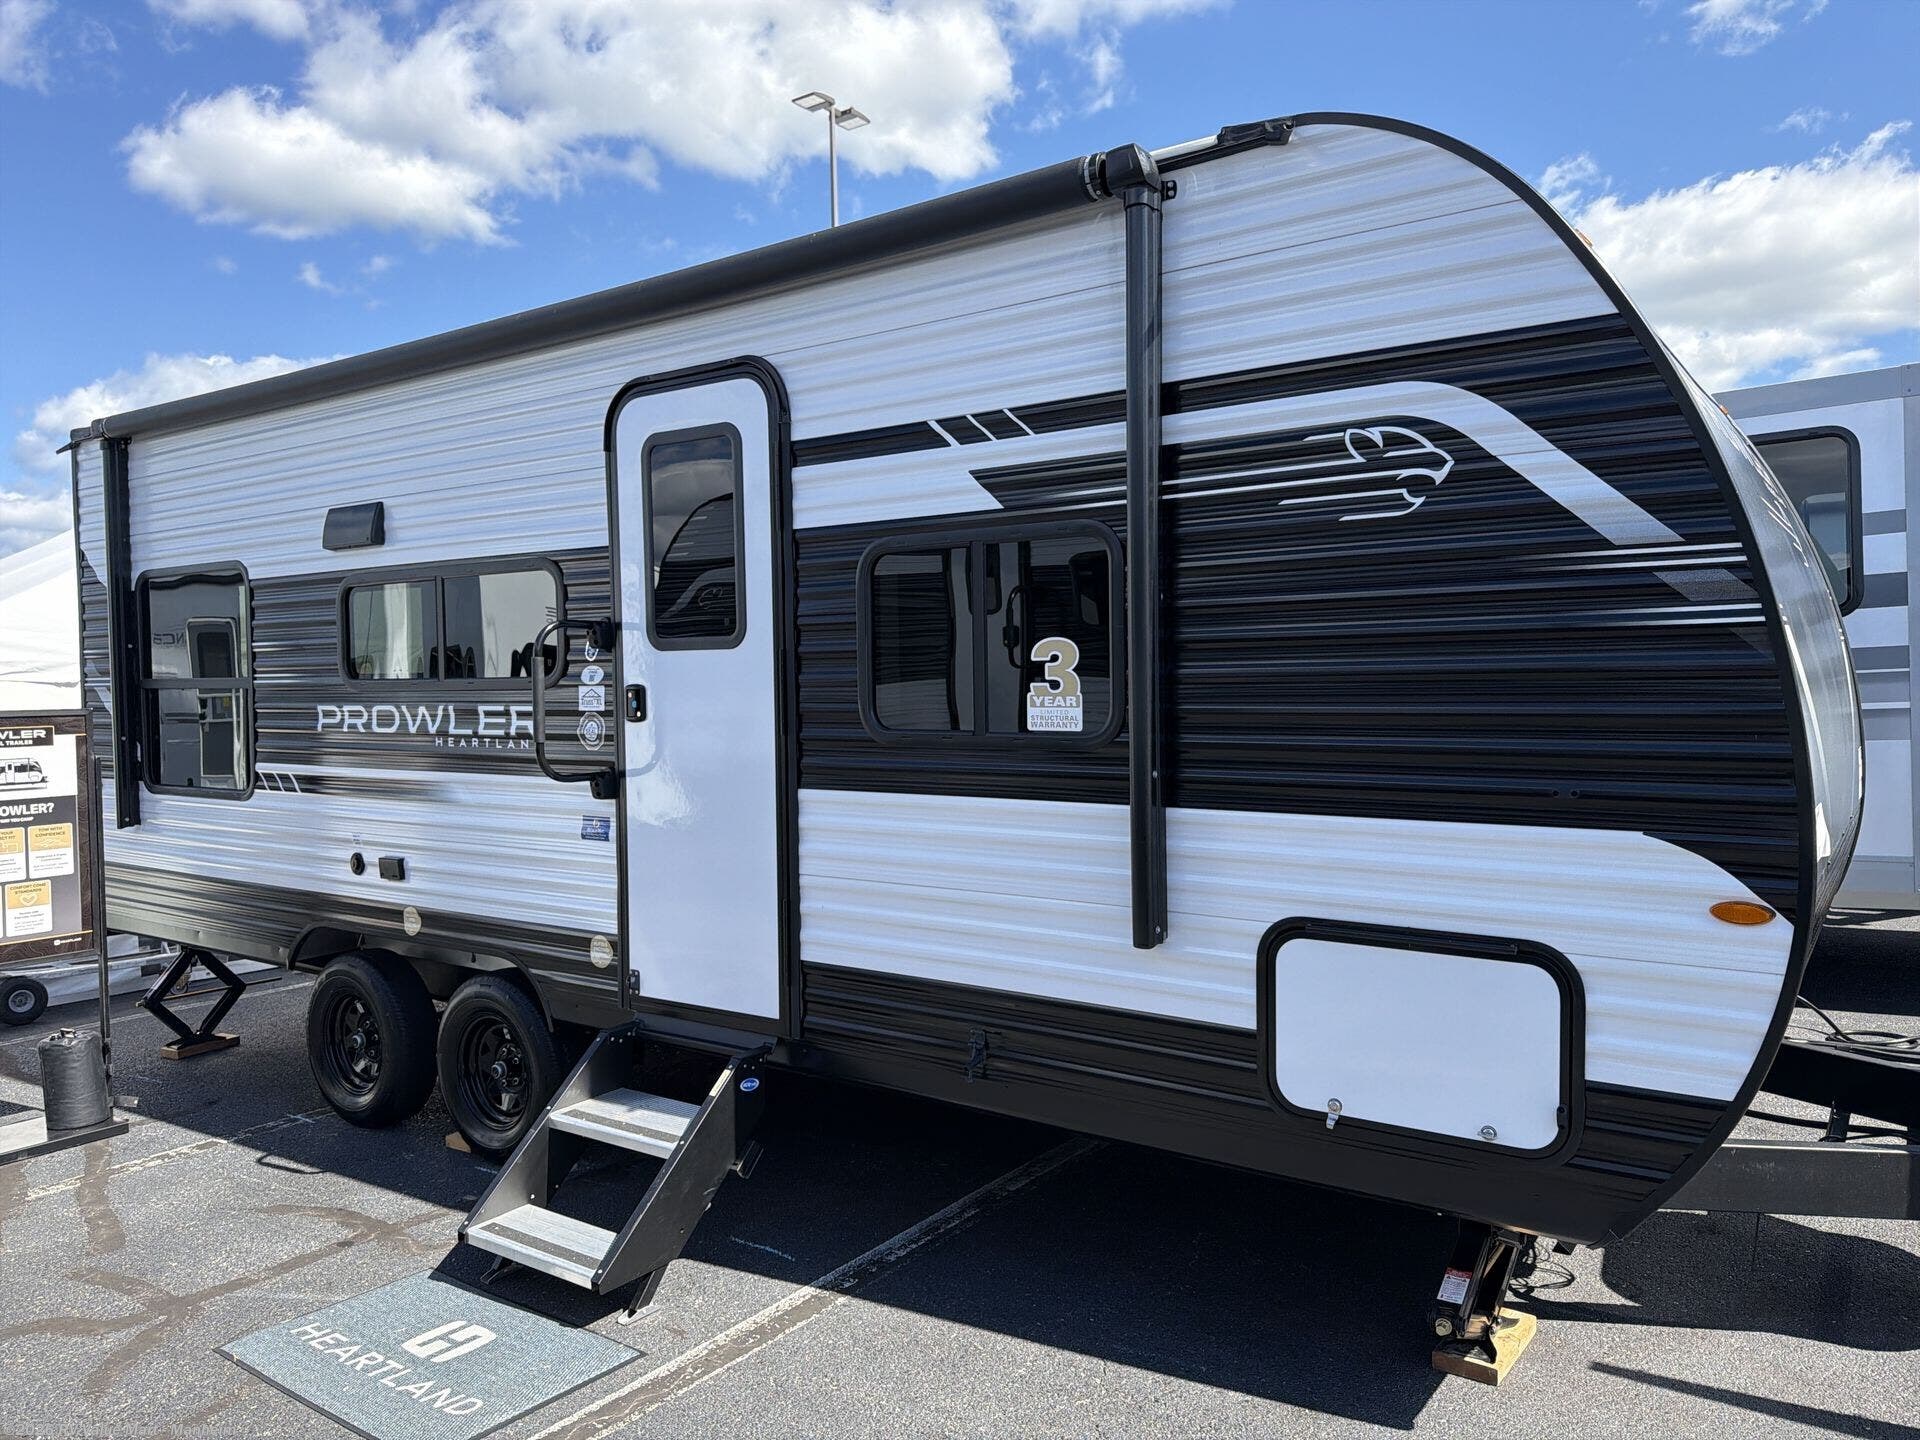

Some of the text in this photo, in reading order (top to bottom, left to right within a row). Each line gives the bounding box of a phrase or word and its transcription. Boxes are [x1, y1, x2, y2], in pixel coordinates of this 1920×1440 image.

[1030, 636, 1081, 696] 3
[1032, 696, 1077, 707] YEAR
[316, 704, 535, 736] PROWLER
[1030, 721, 1079, 729] WARRANTY
[435, 737, 530, 750] HEARTLAN
[288, 1321, 485, 1416] HEARTLAND
